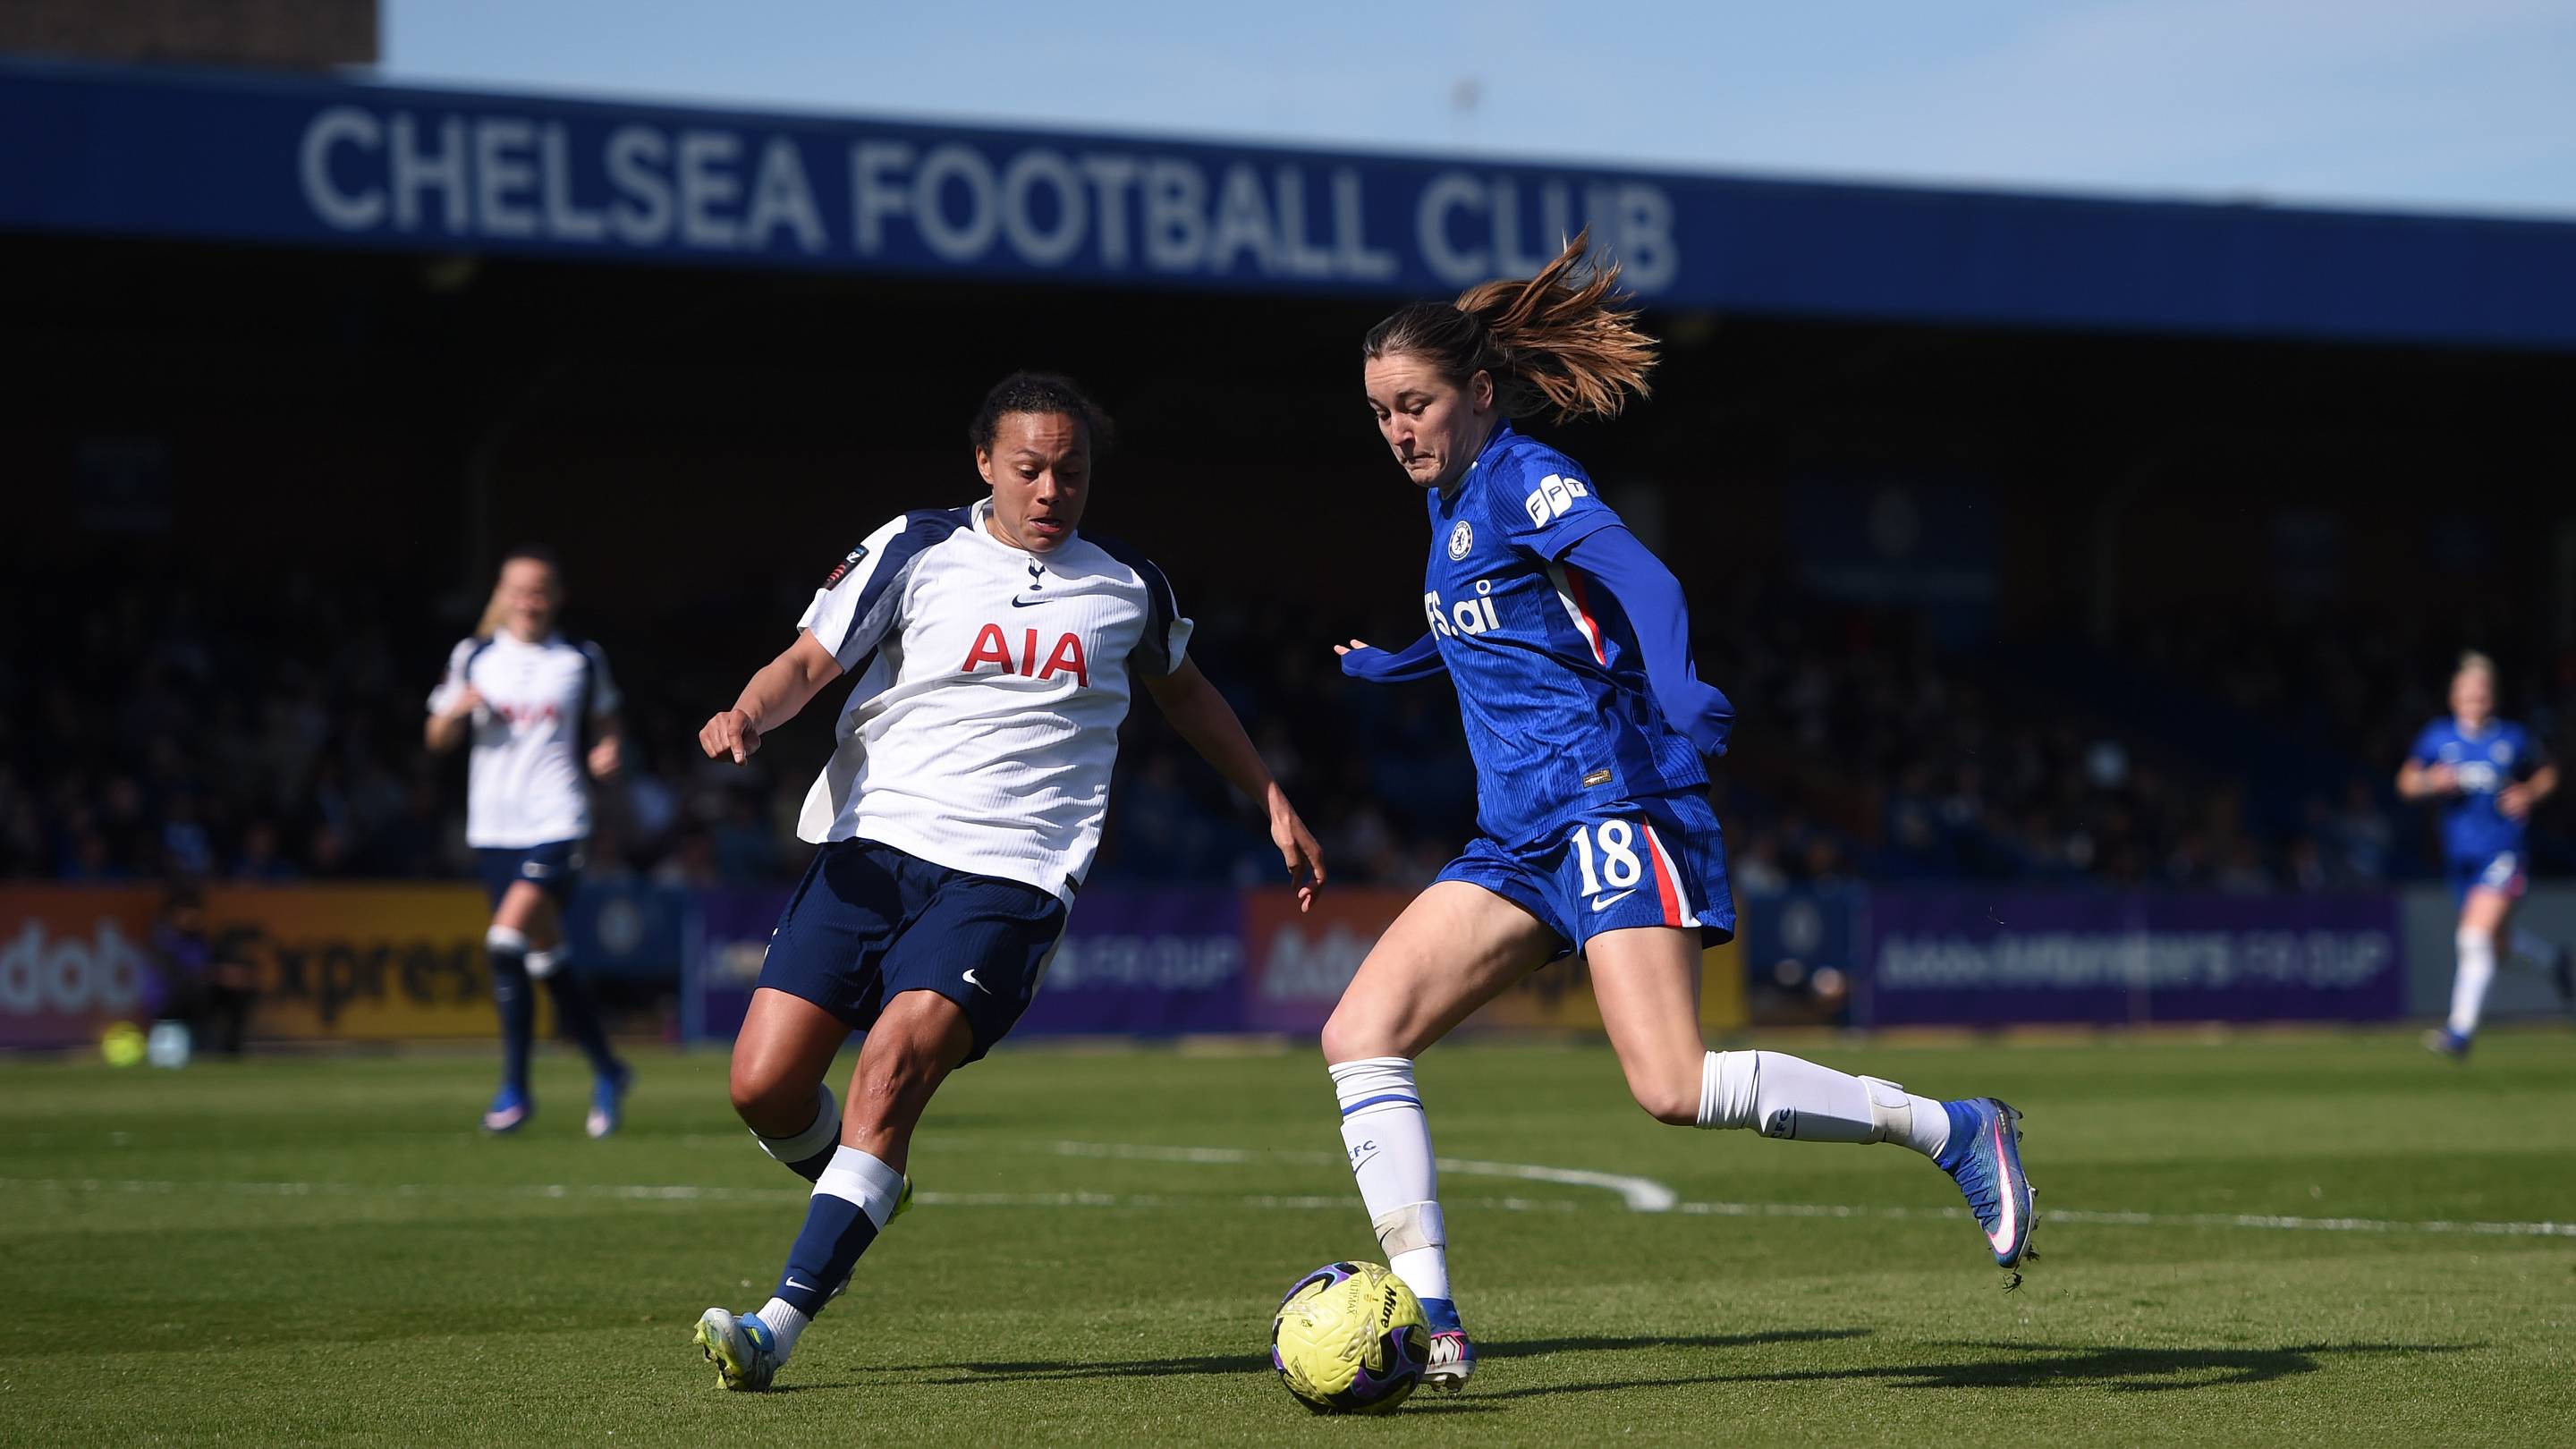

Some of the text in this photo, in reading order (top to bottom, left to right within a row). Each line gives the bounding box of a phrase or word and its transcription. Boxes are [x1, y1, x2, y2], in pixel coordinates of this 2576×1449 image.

[299, 106, 1679, 292] CHELSEA FOOTBALL CLUB
[1529, 479, 1582, 522] FPT
[962, 623, 1089, 688] AIA
[1572, 819, 1641, 897] 18
[0, 914, 484, 1025] dob Expres
